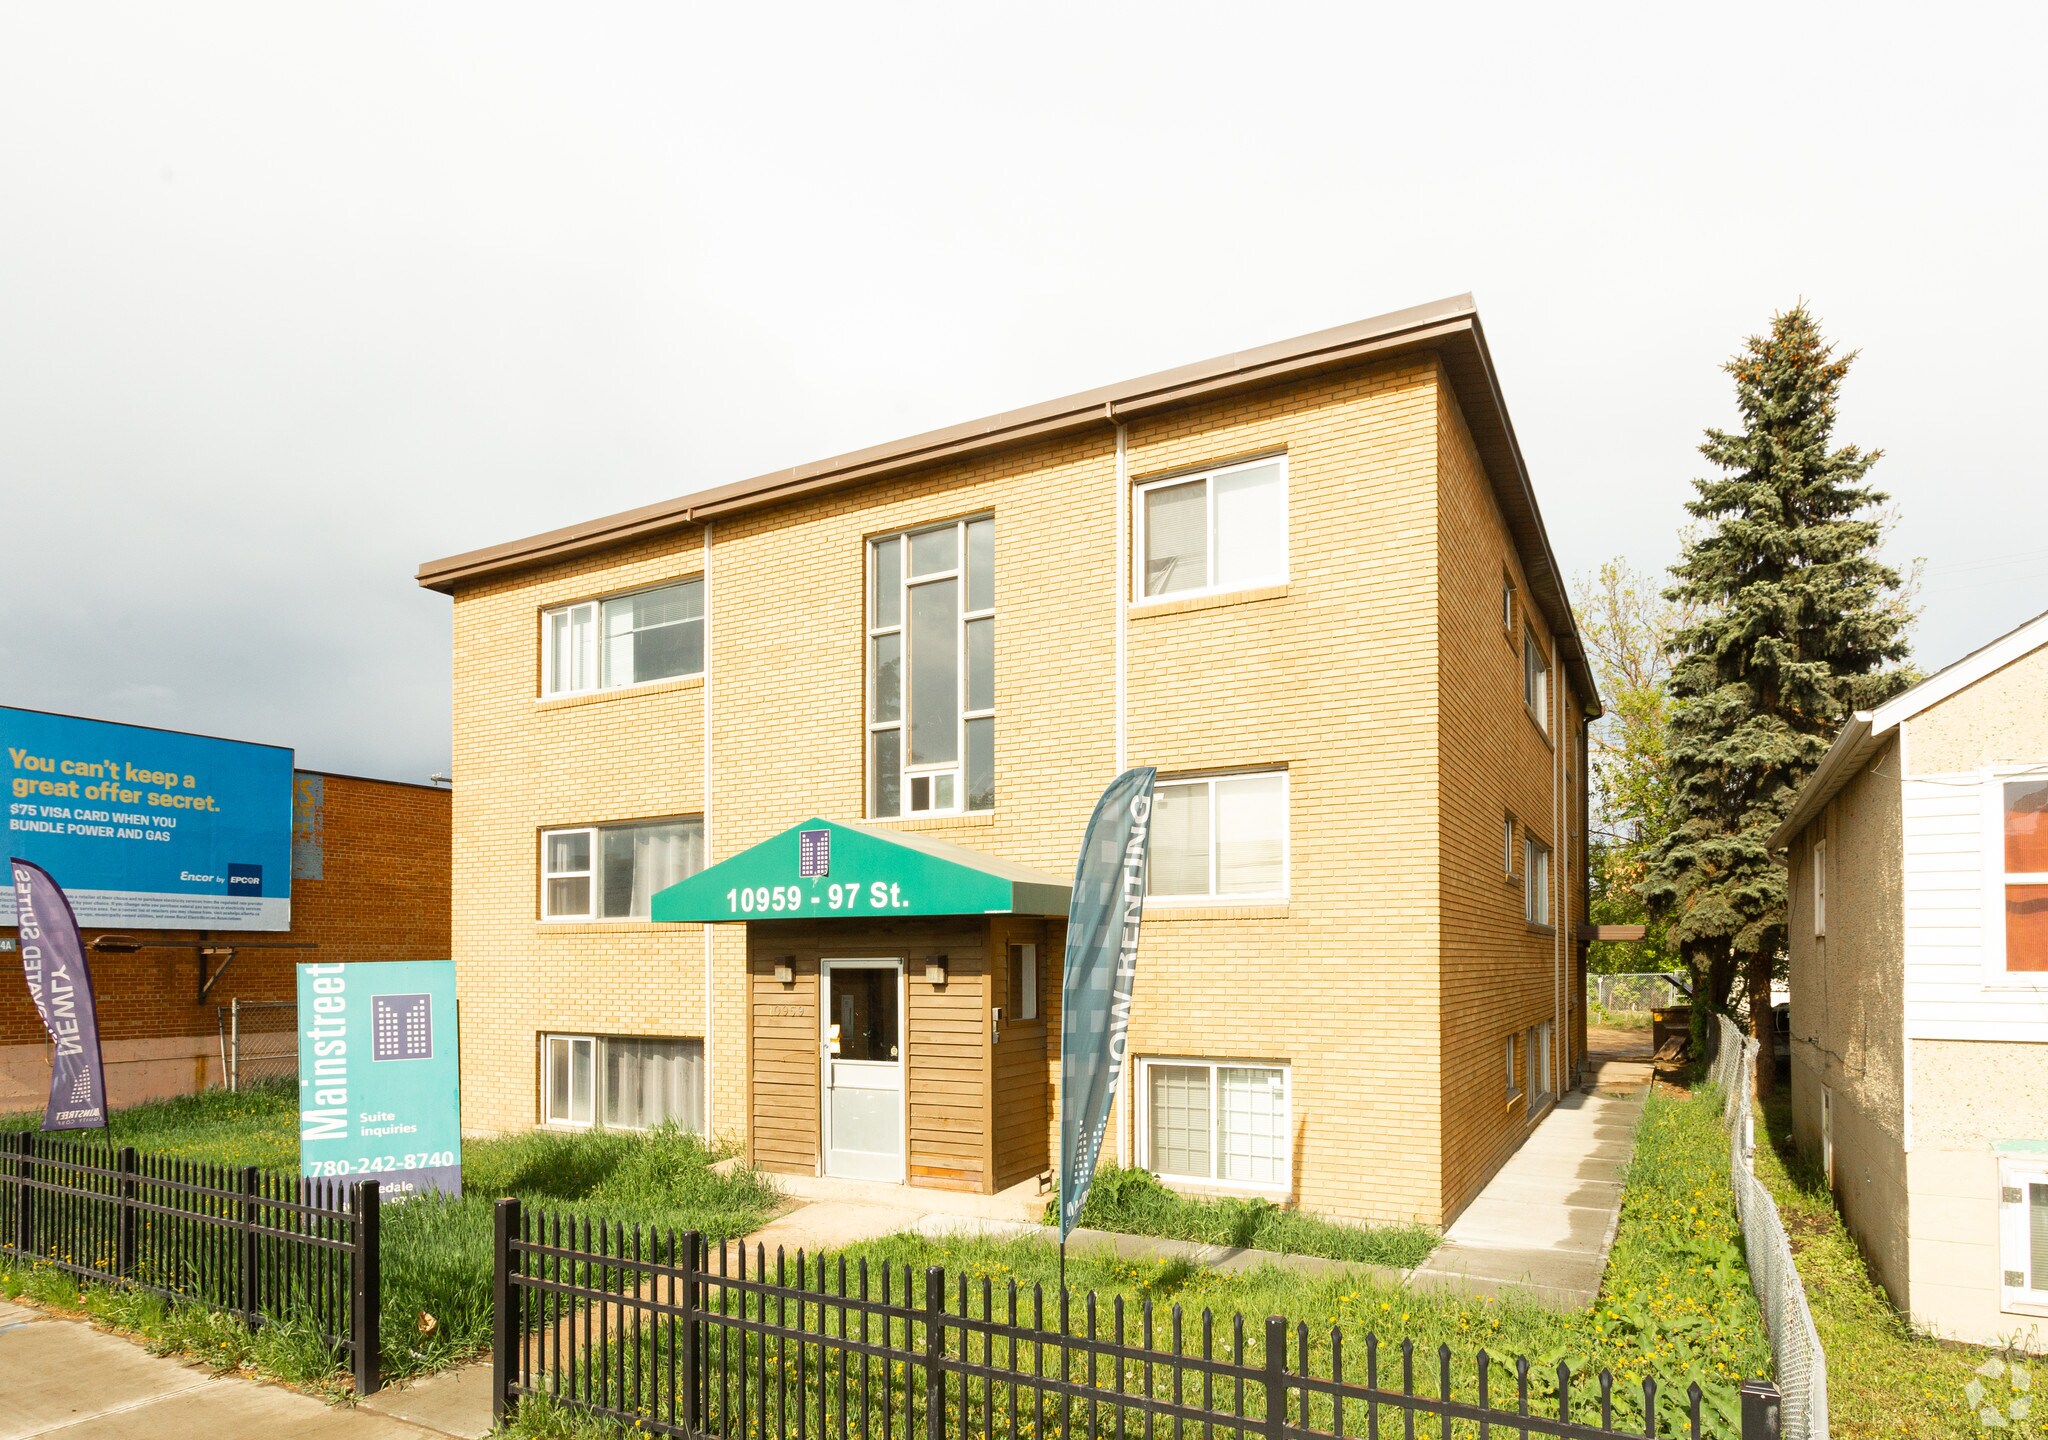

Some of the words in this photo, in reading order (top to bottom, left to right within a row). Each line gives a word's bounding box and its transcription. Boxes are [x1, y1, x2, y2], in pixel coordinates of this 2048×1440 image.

[8, 747, 55, 773] You
[61, 759, 120, 780] can't
[125, 762, 179, 790] keep
[183, 775, 196, 789] a
[12, 777, 79, 798] great
[85, 781, 142, 804] offer
[147, 792, 221, 812] secret.
[10, 803, 37, 816] $75
[39, 806, 71, 819] VISA
[74, 809, 110, 822] CARD
[112, 812, 150, 826] WHEN
[152, 816, 177, 829] YOU
[9, 819, 65, 834] BUNDLE
[67, 823, 114, 838] POWER
[116, 827, 143, 839] AND
[145, 830, 171, 842] GAS
[180, 871, 215, 882] Encor
[230, 876, 260, 885] EPCOR
[1117, 794, 1151, 977] RENTING
[726, 885, 801, 912] 10959
[810, 896, 820, 904] -
[828, 883, 860, 909] 97
[869, 881, 909, 908] St.
[302, 962, 348, 1141] Mainstreet
[360, 1111, 395, 1123] Suite
[361, 1123, 417, 1138] inquiries
[311, 1151, 454, 1177] 780-242-8740
[378, 1181, 414, 1194] edale
